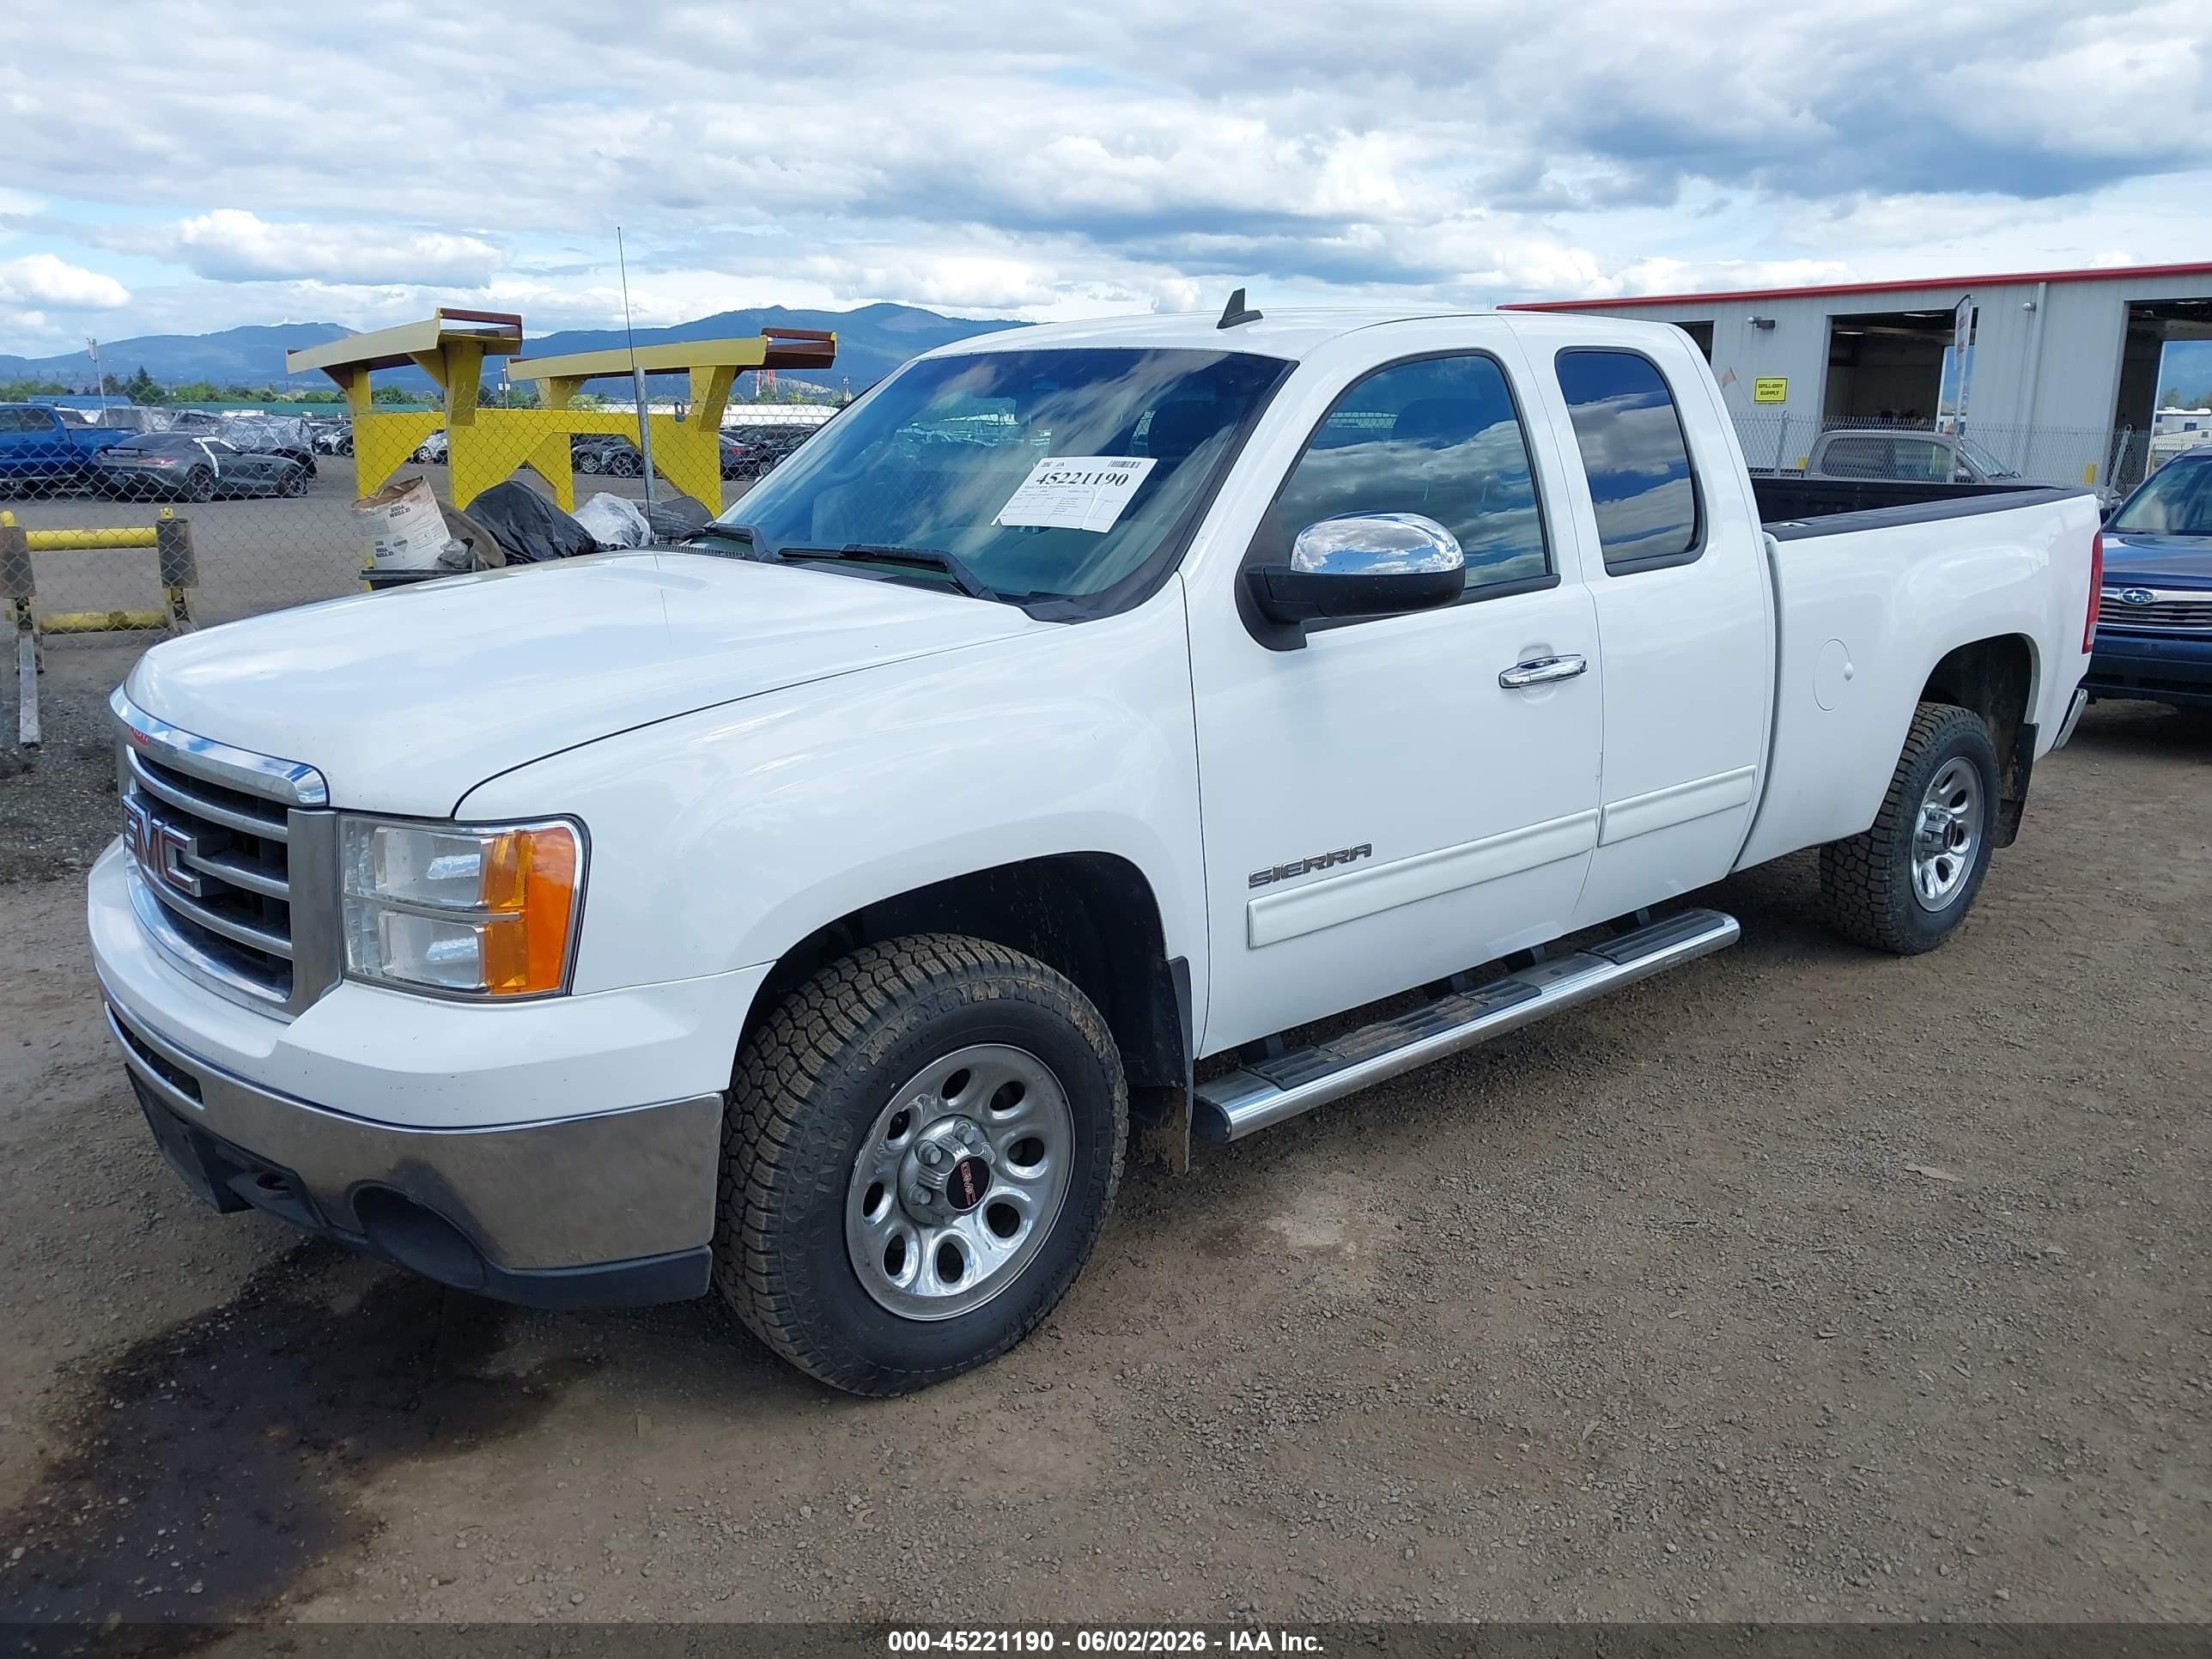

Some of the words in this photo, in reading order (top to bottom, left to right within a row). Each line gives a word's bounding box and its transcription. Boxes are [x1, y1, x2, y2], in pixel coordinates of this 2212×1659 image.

[1036, 471, 1129, 487] 45221190
[122, 795, 202, 897] GMC
[1248, 842, 1374, 890] SIERRA
[961, 1161, 976, 1206] GMC
